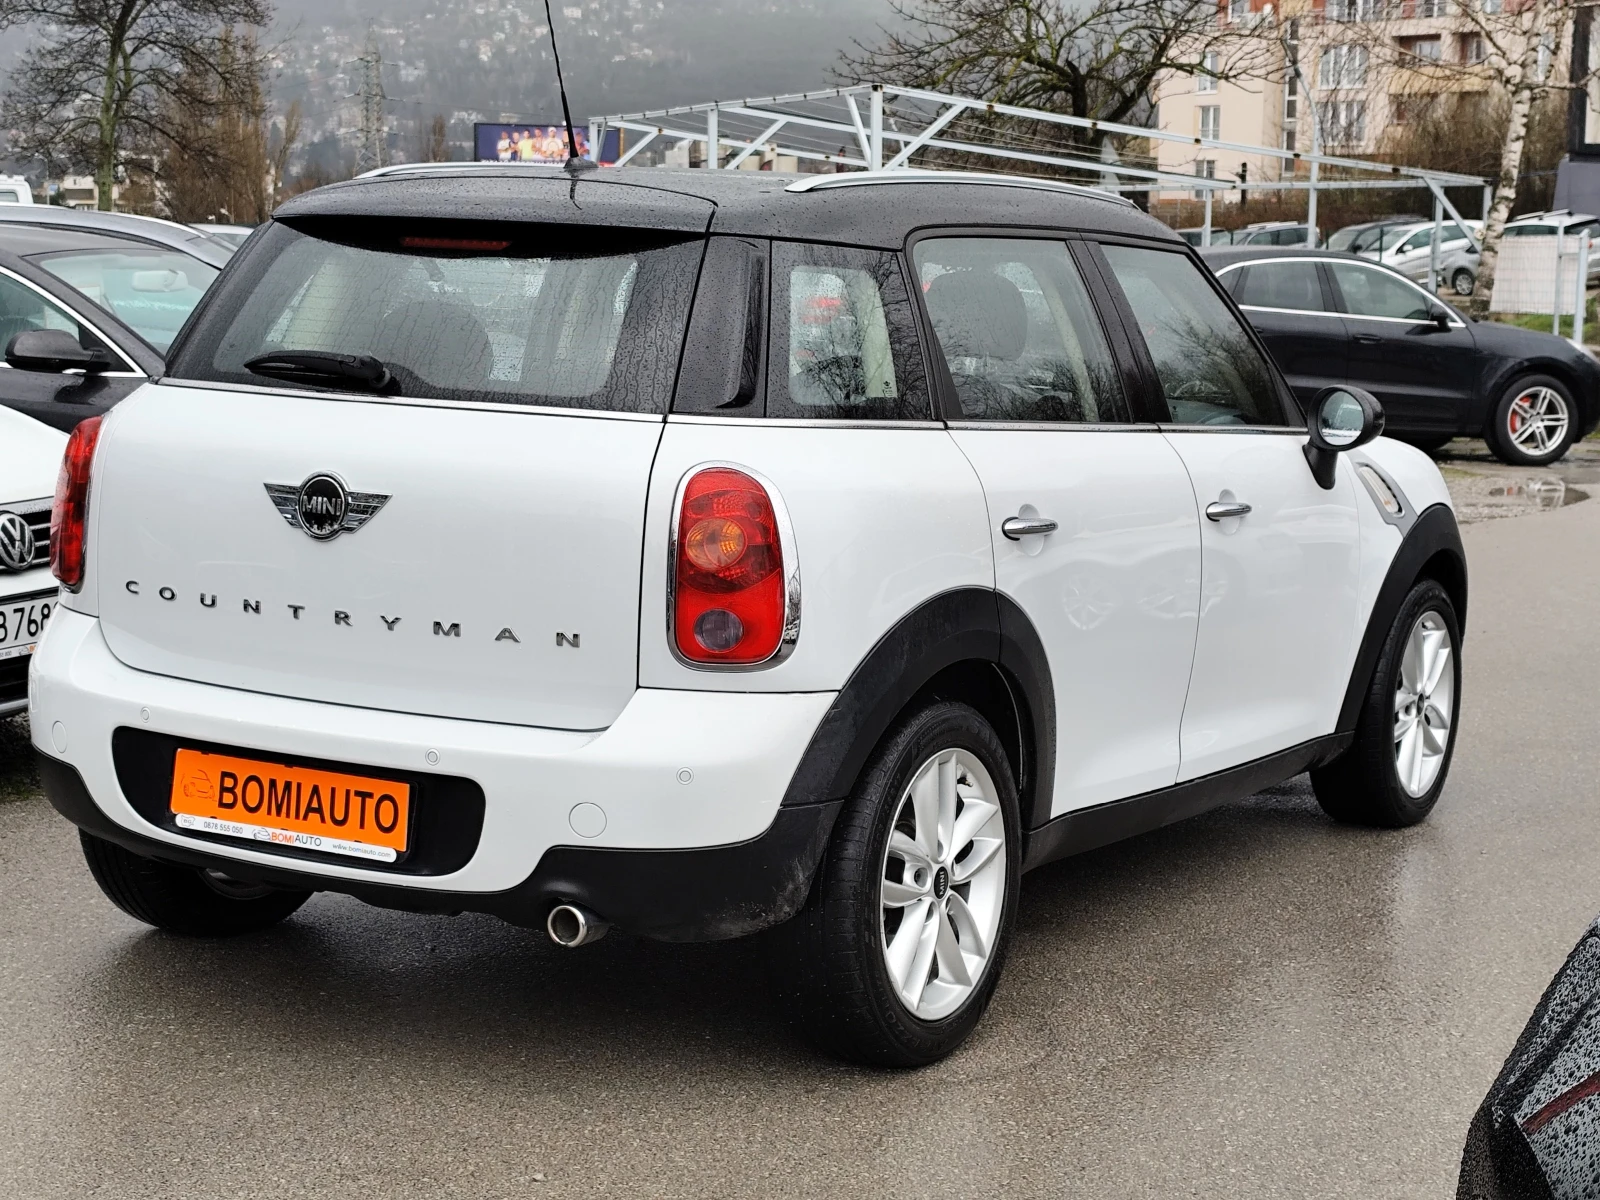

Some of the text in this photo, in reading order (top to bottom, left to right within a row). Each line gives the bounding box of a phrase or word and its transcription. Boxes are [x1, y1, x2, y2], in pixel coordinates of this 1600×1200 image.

[302, 495, 342, 516] MINI
[125, 579, 581, 648] COUNTRYMAN
[218, 771, 399, 834] BOMIAUTO
[220, 824, 231, 832] 555
[232, 826, 243, 834] 050
[332, 842, 392, 859] www.bomiauto.com
